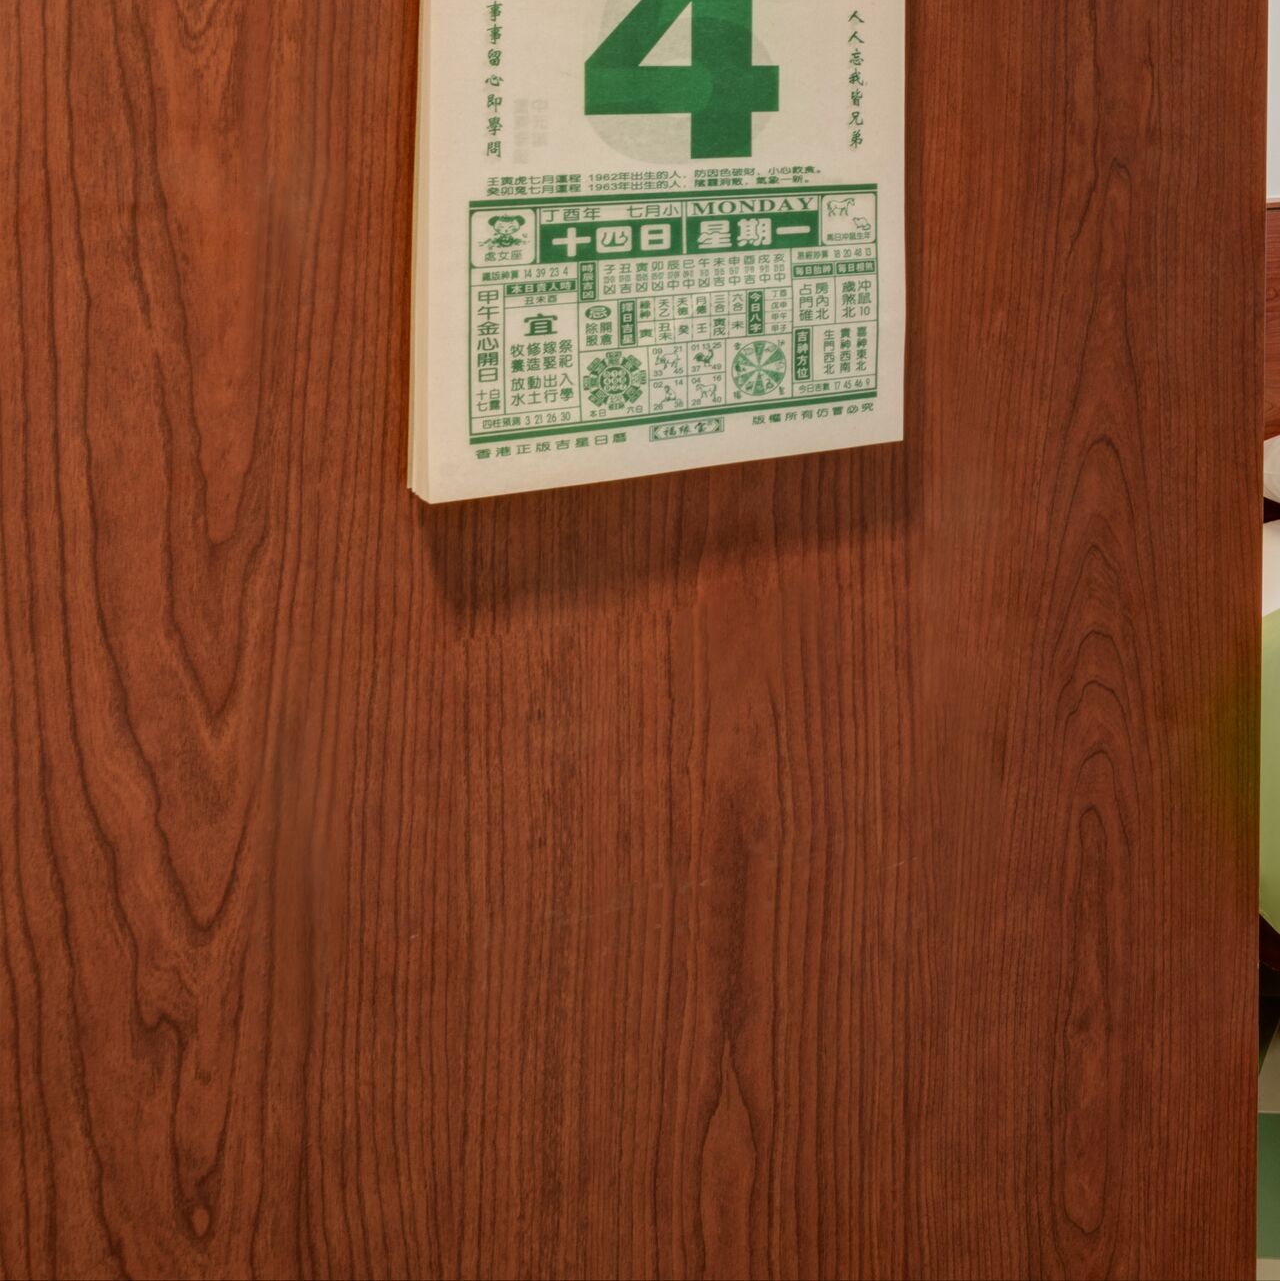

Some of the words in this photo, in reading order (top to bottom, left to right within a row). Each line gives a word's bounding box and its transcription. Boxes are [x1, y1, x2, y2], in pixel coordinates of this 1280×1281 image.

[485, 0, 504, 157] 事事留心即學問
[848, 10, 865, 149] 人人忘我皆兄弟
[543, 207, 601, 223] 丁酉年
[626, 203, 680, 219] 七月小
[692, 197, 815, 216] MONDAY
[551, 223, 672, 258] 十四日
[697, 217, 811, 250] 星期一
[484, 249, 523, 262] 處女座
[523, 313, 558, 337] 宜
